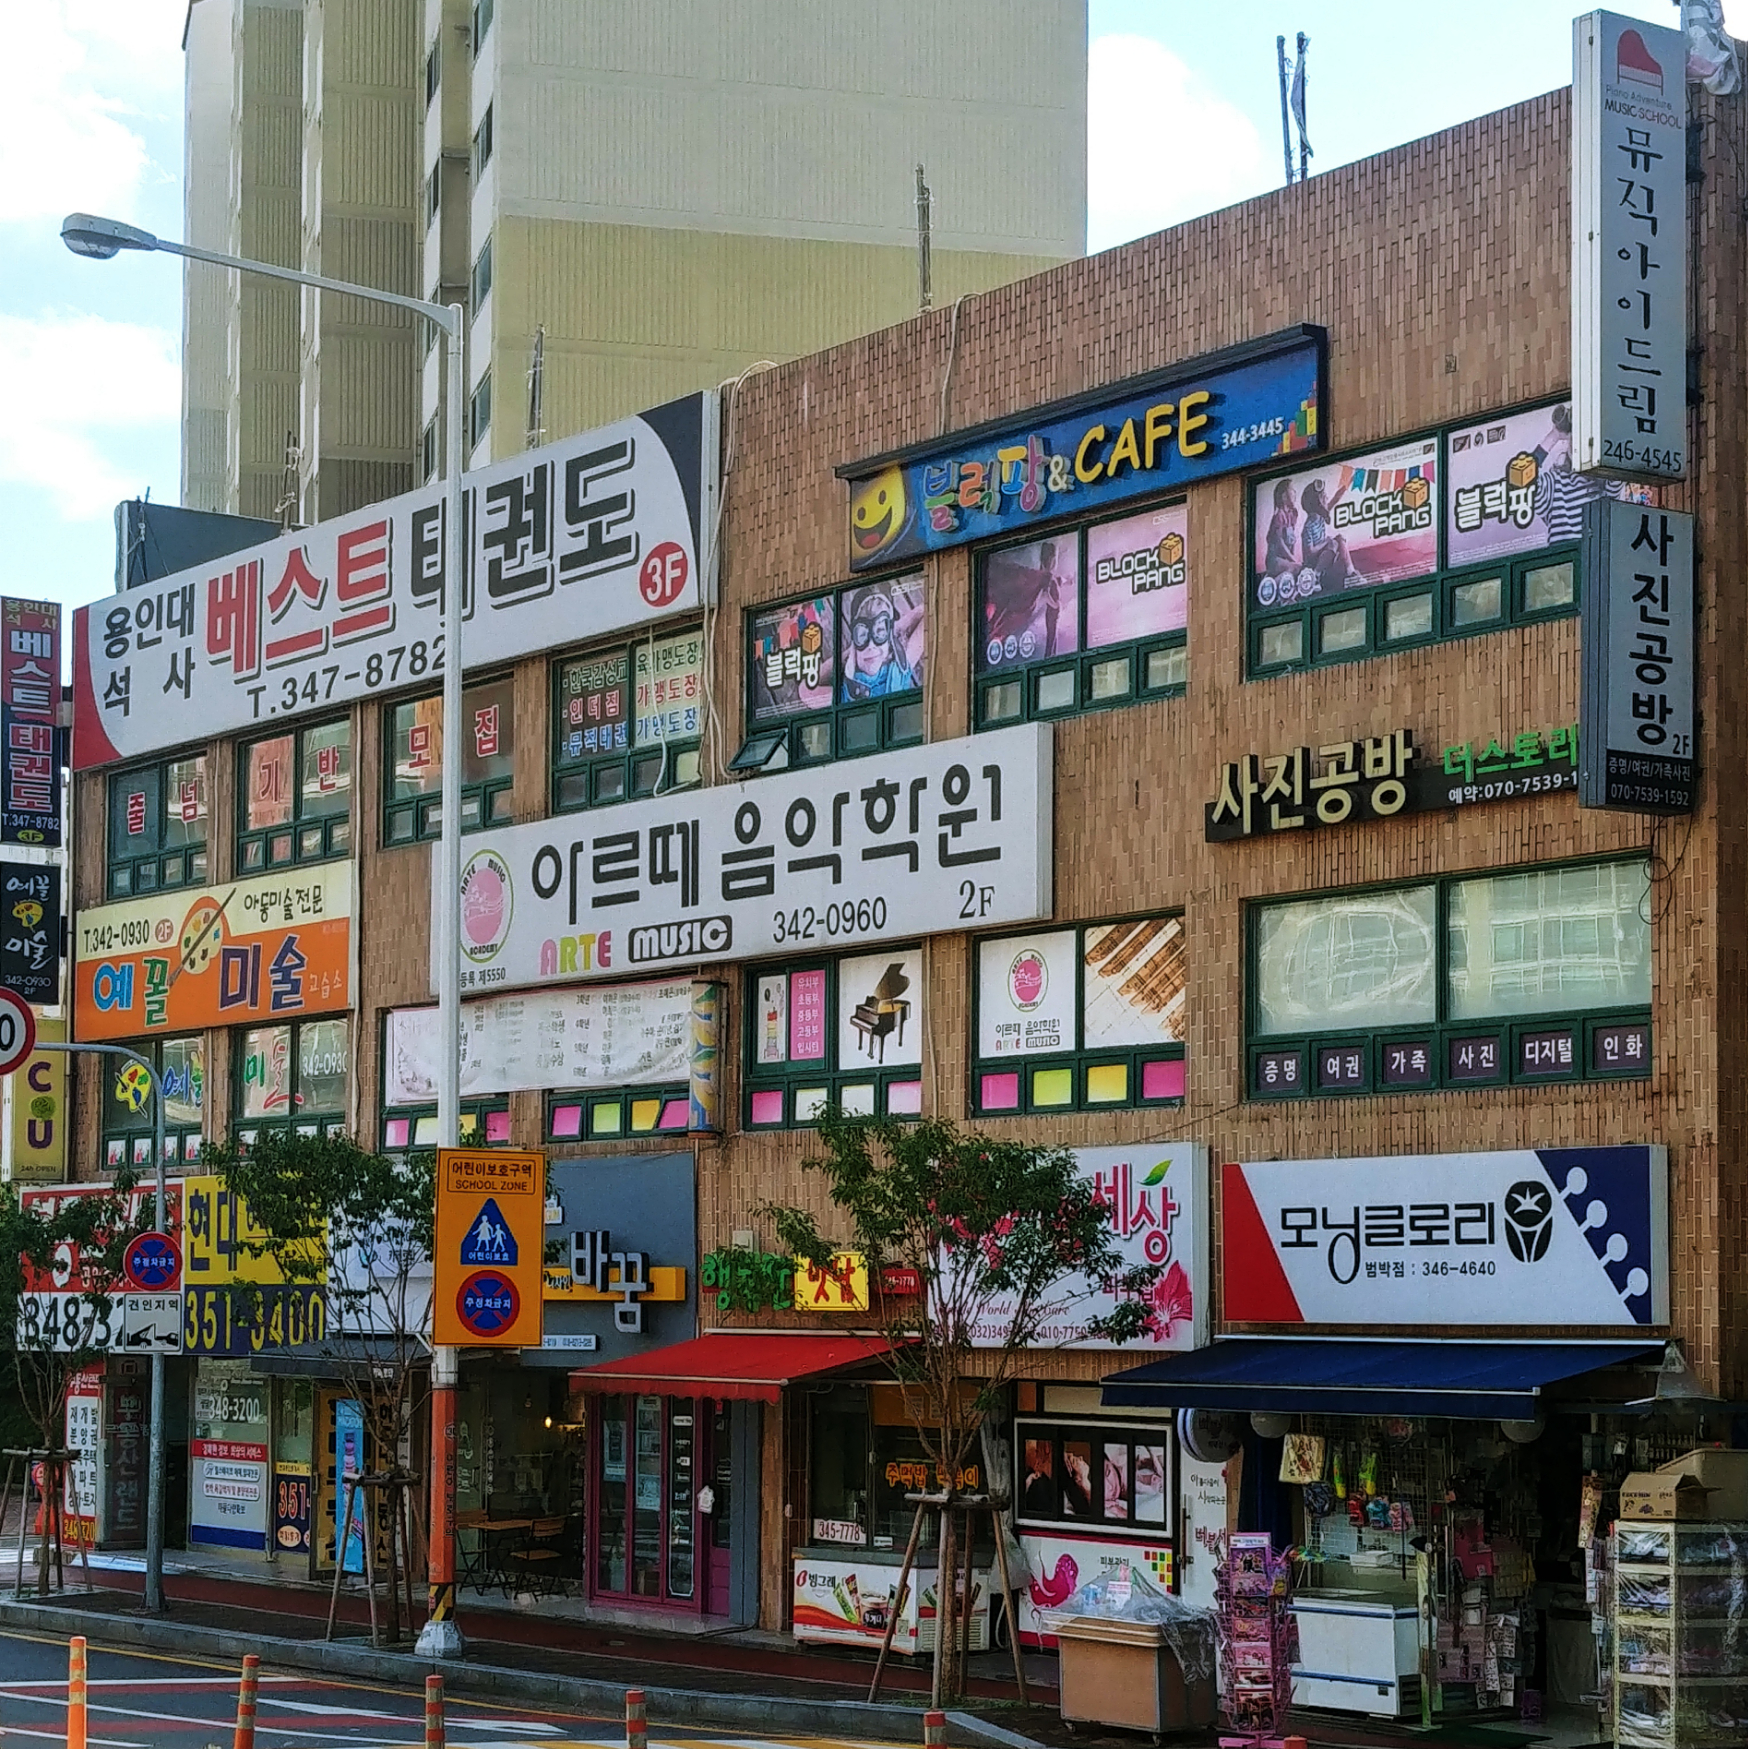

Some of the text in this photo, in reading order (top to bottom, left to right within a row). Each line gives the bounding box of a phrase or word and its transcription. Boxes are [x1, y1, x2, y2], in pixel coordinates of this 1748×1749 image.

[1605, 98, 1682, 130] MUSIC SCHOOL
[1617, 126, 1664, 436] 뮤직아이드림
[1074, 391, 1210, 484] CAFE
[1221, 417, 1284, 450] 344-3445
[1603, 439, 1682, 473] 246-4545
[1334, 490, 1404, 529] BLOCK
[1373, 506, 1431, 537] PANG
[1454, 481, 1537, 529] 블럭팡
[205, 437, 639, 684] 베스트 태권도
[646, 556, 684, 595] 3F
[1097, 548, 1160, 582] BLOCK
[1133, 562, 1185, 594] PANG
[5, 599, 58, 617] 용인대
[103, 582, 196, 659] 용인대
[1628, 514, 1676, 746] 사진공방
[248, 634, 446, 718] T.347-8782
[766, 646, 821, 688] 블럭팡
[8, 628, 53, 813] 베스트 태권도
[1443, 723, 1579, 783] 더스토리
[1673, 733, 1690, 756] 2F
[1211, 728, 1415, 835] 사진공방
[1610, 783, 1690, 806] 070-7539-1592
[2, 812, 60, 831] T.347-8782
[20, 829, 43, 842] 3F
[531, 763, 1002, 926] 아르떼 음악학원
[460, 858, 506, 895] ARTE MUSIC
[958, 879, 996, 920] 2F
[84, 919, 151, 954] T.342-0930
[157, 923, 173, 940] 2F
[772, 895, 887, 944] 342-0960
[4, 930, 54, 970] 미술
[540, 930, 612, 976] ARTE
[4, 974, 52, 988] 342-0930
[24, 986, 37, 996] 2F
[94, 956, 171, 1028] 예꼴
[218, 934, 308, 1012] 미술
[478, 967, 506, 985] 제5550
[1263, 1034, 1644, 1084] 증명 여권 가족 사진 디지털 인화
[452, 1161, 532, 1179] 어린이보호구역
[455, 1179, 528, 1192] SCHOOL ZONE
[1089, 1163, 1178, 1265] 세상
[467, 1251, 510, 1262] 어린이보호
[1280, 1201, 1496, 1285] 모닝글로리
[1365, 1260, 1496, 1279] 범박점 346-4640
[464, 1296, 512, 1310] 주정차금지
[208, 1396, 261, 1422] 348-3200
[885, 1462, 928, 1490] 주먹밥
[818, 1520, 860, 1543] 345-7778
[808, 1573, 836, 1589] 빙그레
